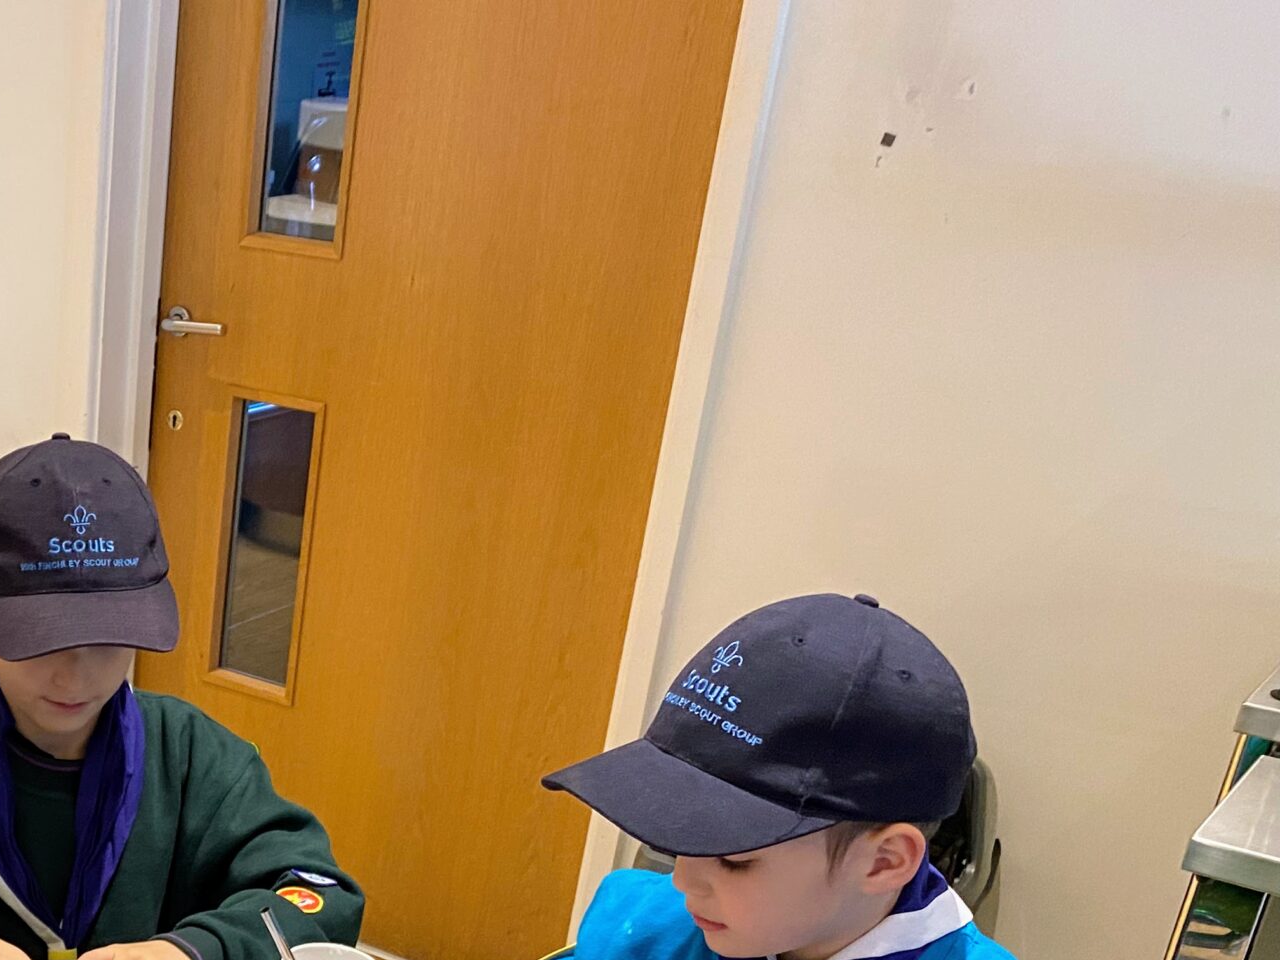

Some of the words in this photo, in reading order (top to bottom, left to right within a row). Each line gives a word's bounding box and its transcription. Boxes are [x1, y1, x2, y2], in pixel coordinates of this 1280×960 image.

[48, 537, 115, 554] Scouts
[83, 558, 111, 567] SCOUT
[113, 557, 140, 567] GROUP
[683, 669, 742, 712] Scouts
[688, 702, 722, 725] SCOUT
[721, 720, 764, 746] GROUP
